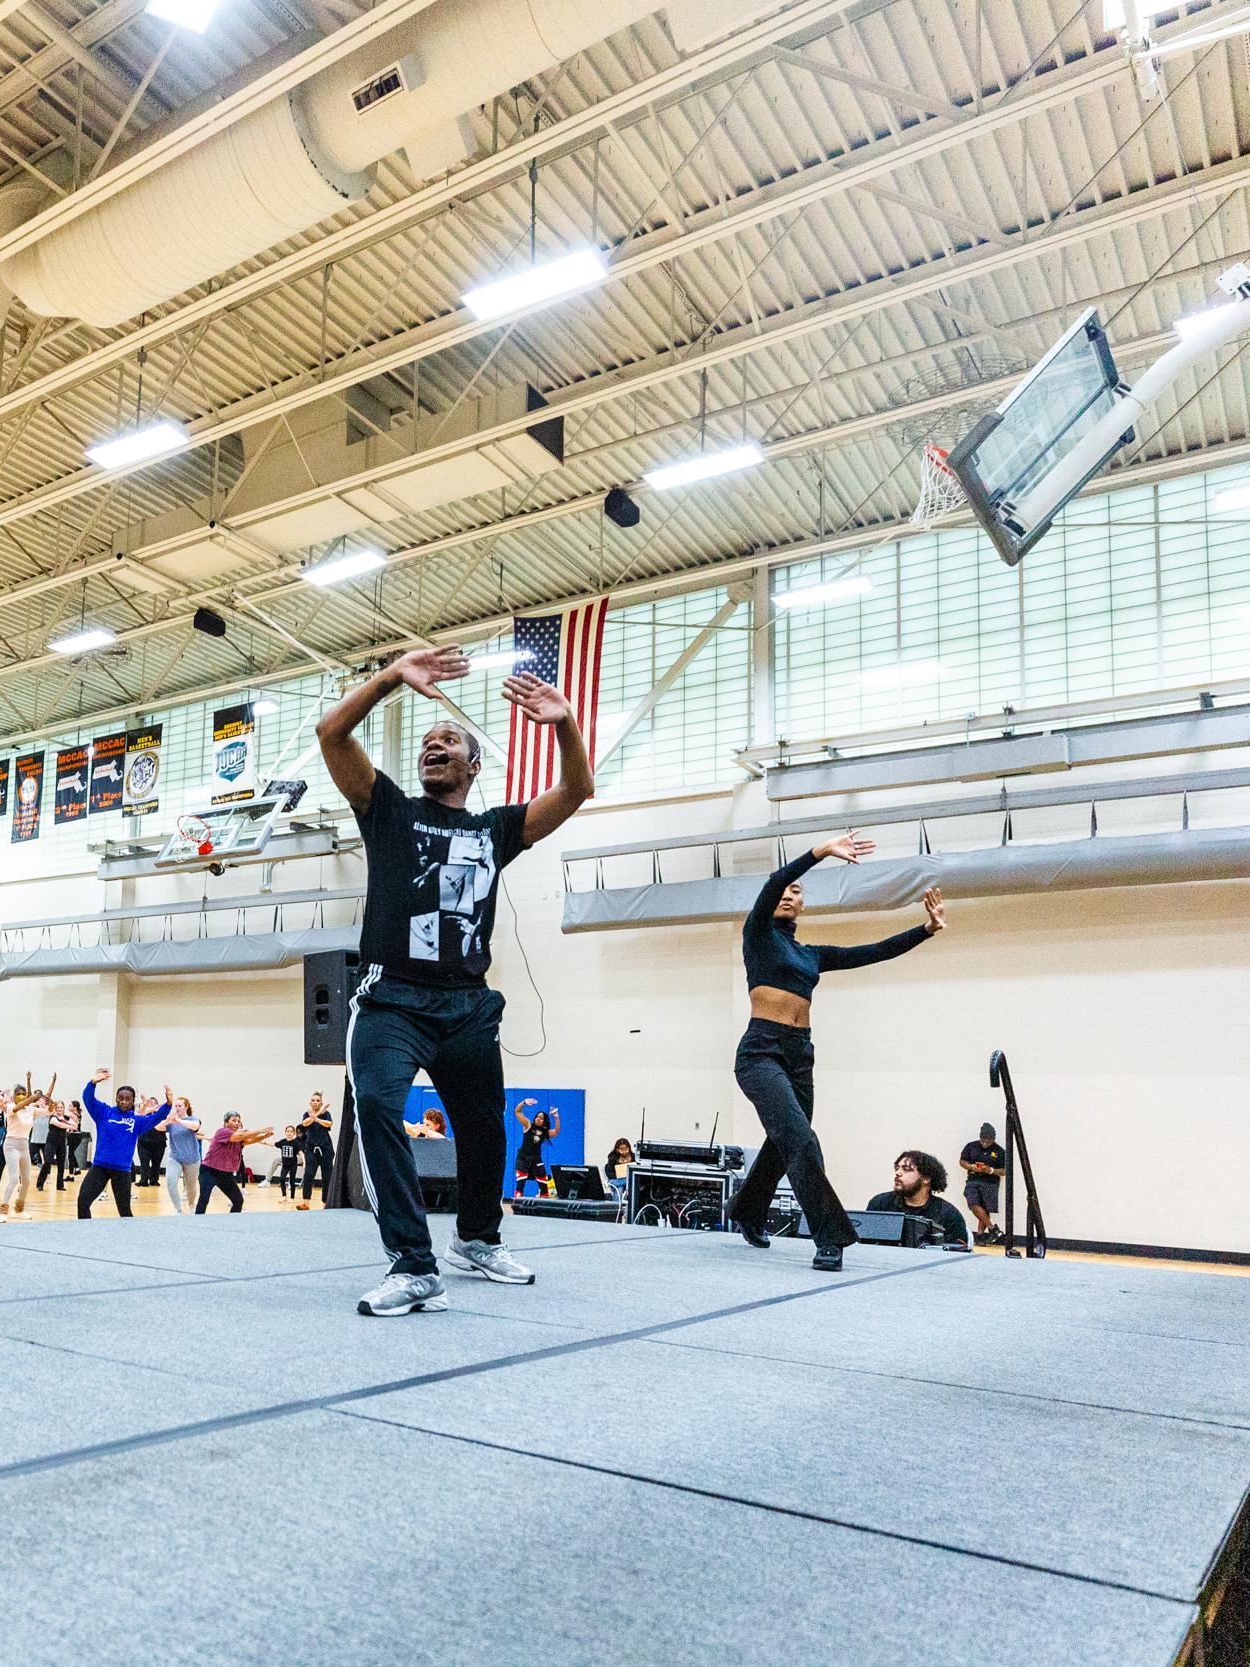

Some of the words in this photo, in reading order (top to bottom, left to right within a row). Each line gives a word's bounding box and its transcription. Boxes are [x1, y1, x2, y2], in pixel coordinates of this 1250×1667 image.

[94, 737, 126, 751] MCCAC
[58, 749, 89, 764] MCCAC
[103, 791, 122, 800] Place
[68, 802, 87, 811] Place
